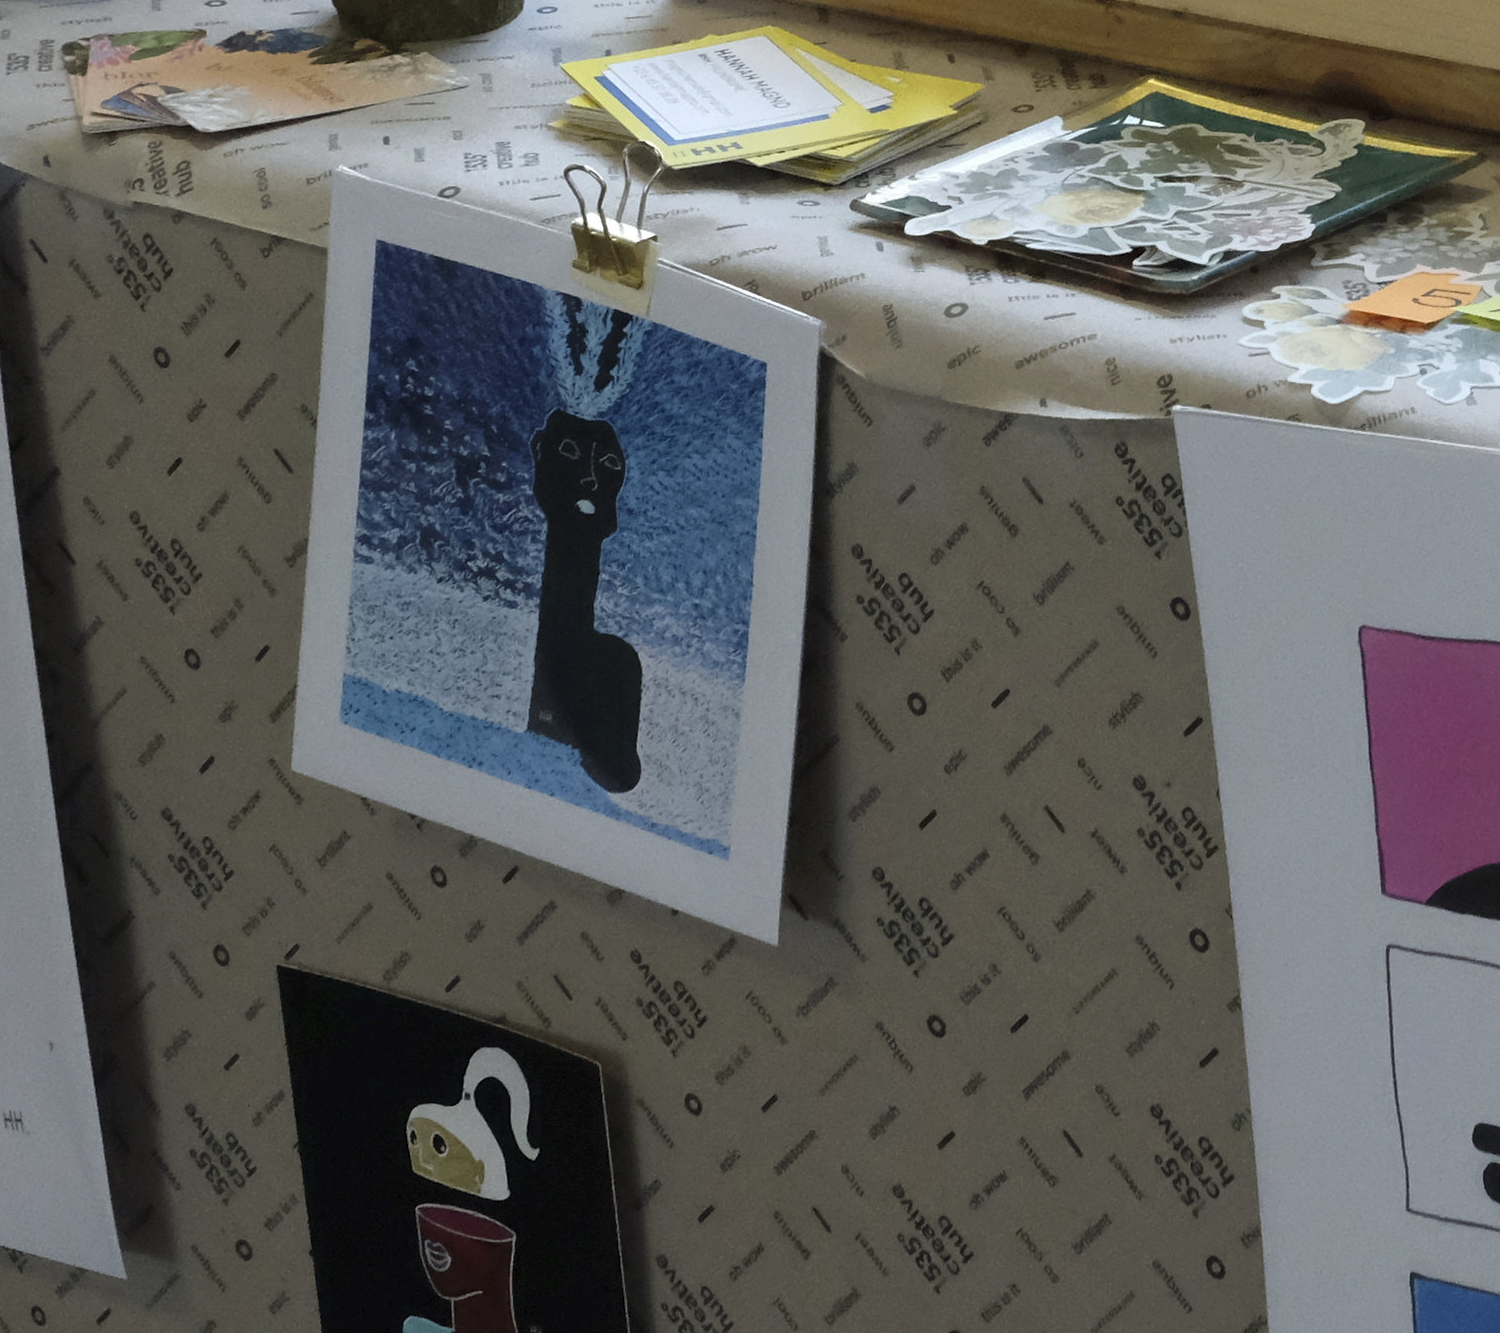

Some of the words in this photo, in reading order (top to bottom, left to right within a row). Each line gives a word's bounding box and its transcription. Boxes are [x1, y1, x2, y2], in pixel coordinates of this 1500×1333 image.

[714, 48, 757, 84] HANNAH
[754, 80, 792, 110] MAGNO
[102, 207, 163, 293] creative
[142, 232, 175, 281] hub
[105, 254, 152, 312] 1535°
[801, 271, 868, 302] brilliant
[1412, 288, 1468, 310] 5
[946, 343, 982, 371] epic
[1013, 332, 1099, 371] awesome
[1112, 439, 1184, 541] creative
[129, 509, 192, 597] creative
[1114, 493, 1168, 562] 1535°
[134, 556, 183, 616] 1535°
[170, 536, 204, 585] hub
[628, 946, 698, 1041] creative
[672, 979, 710, 1030] hub
[744, 989, 774, 1025] cool
[635, 995, 687, 1059] 1535°
[873, 1019, 916, 1076] unique
[1149, 1101, 1221, 1202] creative
[1196, 1134, 1235, 1190] hub
[1153, 1151, 1206, 1221] 1535°
